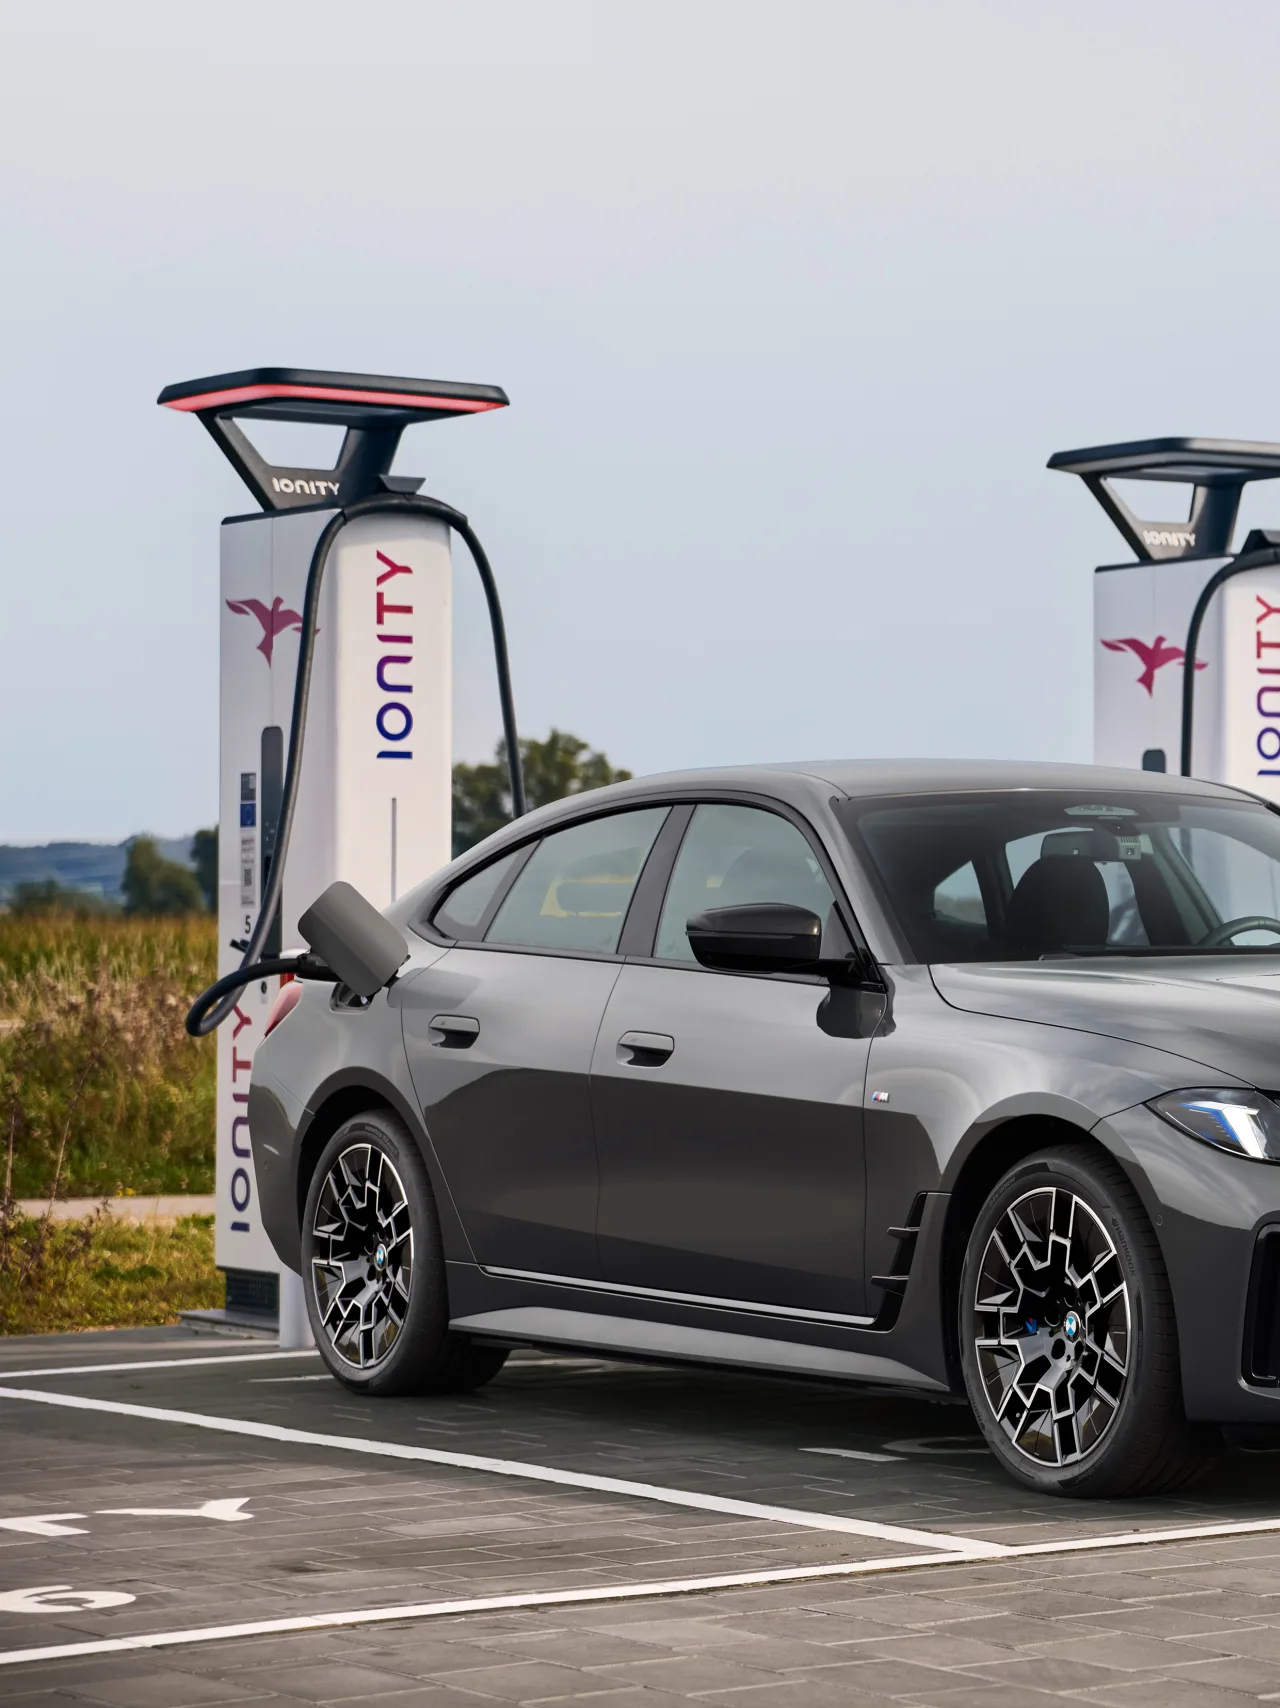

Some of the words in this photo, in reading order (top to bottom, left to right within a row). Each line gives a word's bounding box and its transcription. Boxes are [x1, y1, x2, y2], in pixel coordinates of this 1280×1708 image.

[272, 477, 340, 496] IONITY
[376, 549, 414, 760] IONITY
[244, 914, 251, 934] 5
